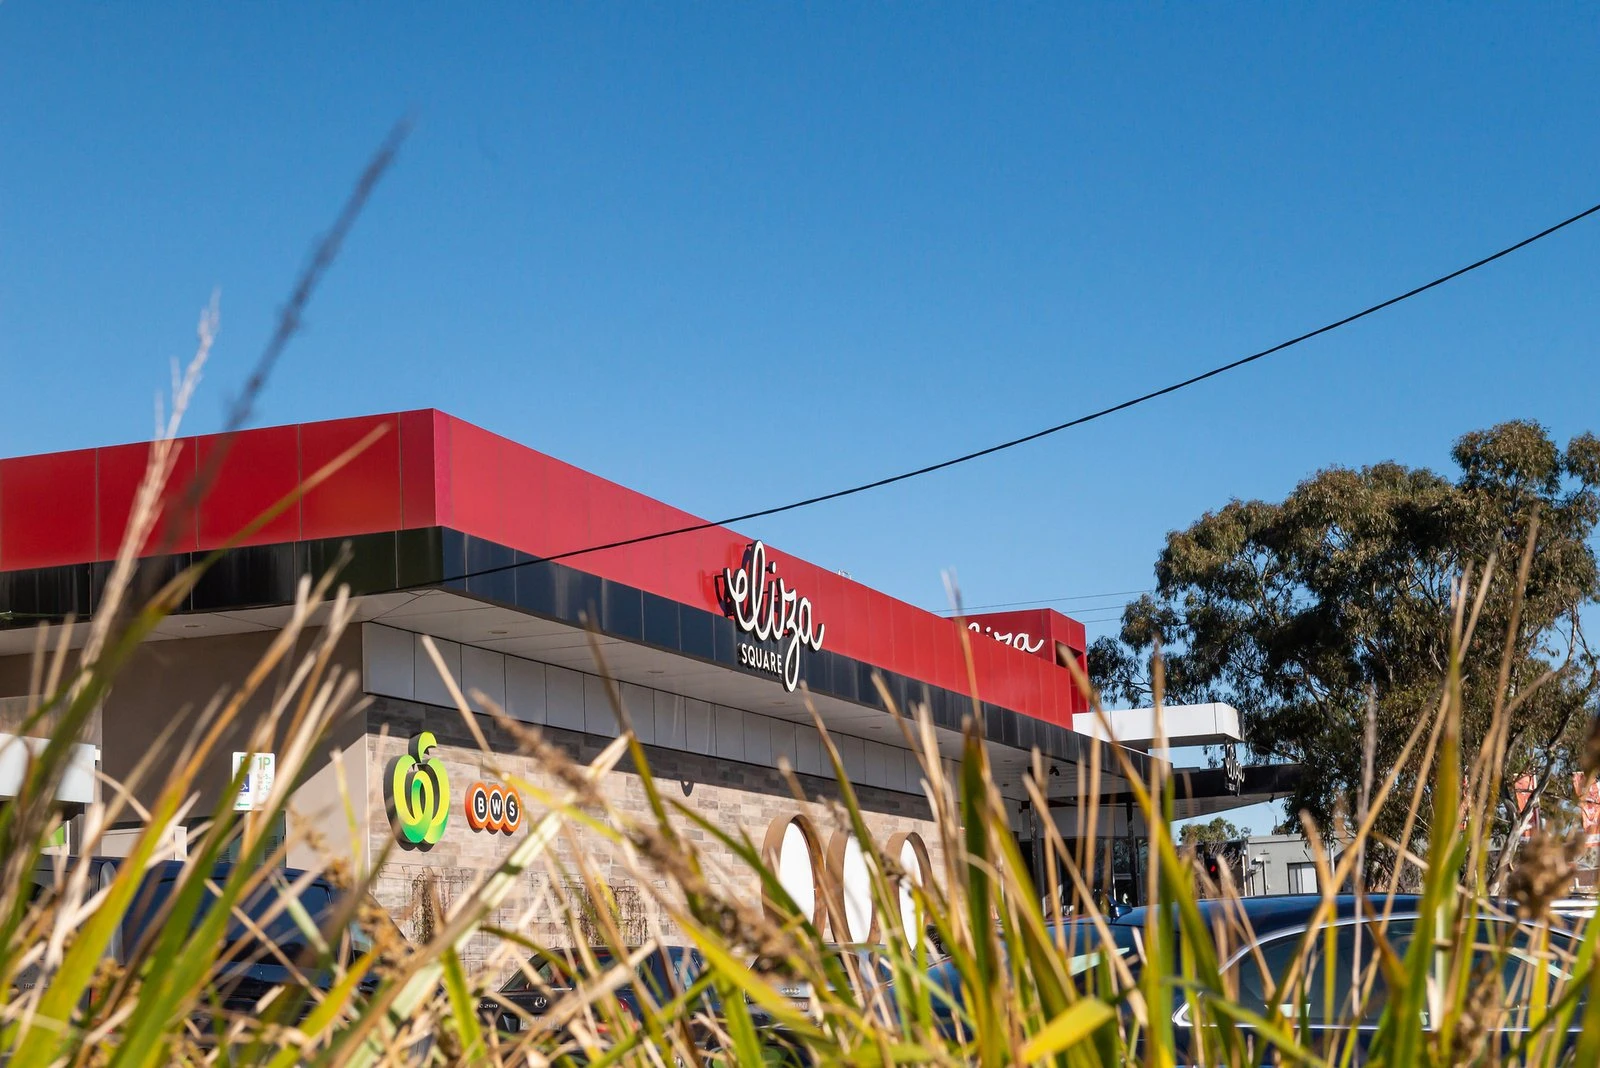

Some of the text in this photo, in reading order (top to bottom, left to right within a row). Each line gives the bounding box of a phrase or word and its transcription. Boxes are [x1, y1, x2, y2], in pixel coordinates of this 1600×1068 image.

[727, 540, 825, 693] eliza
[741, 643, 783, 673] SQUARE
[258, 756, 271, 770] 1P
[477, 797, 515, 817] BWS
